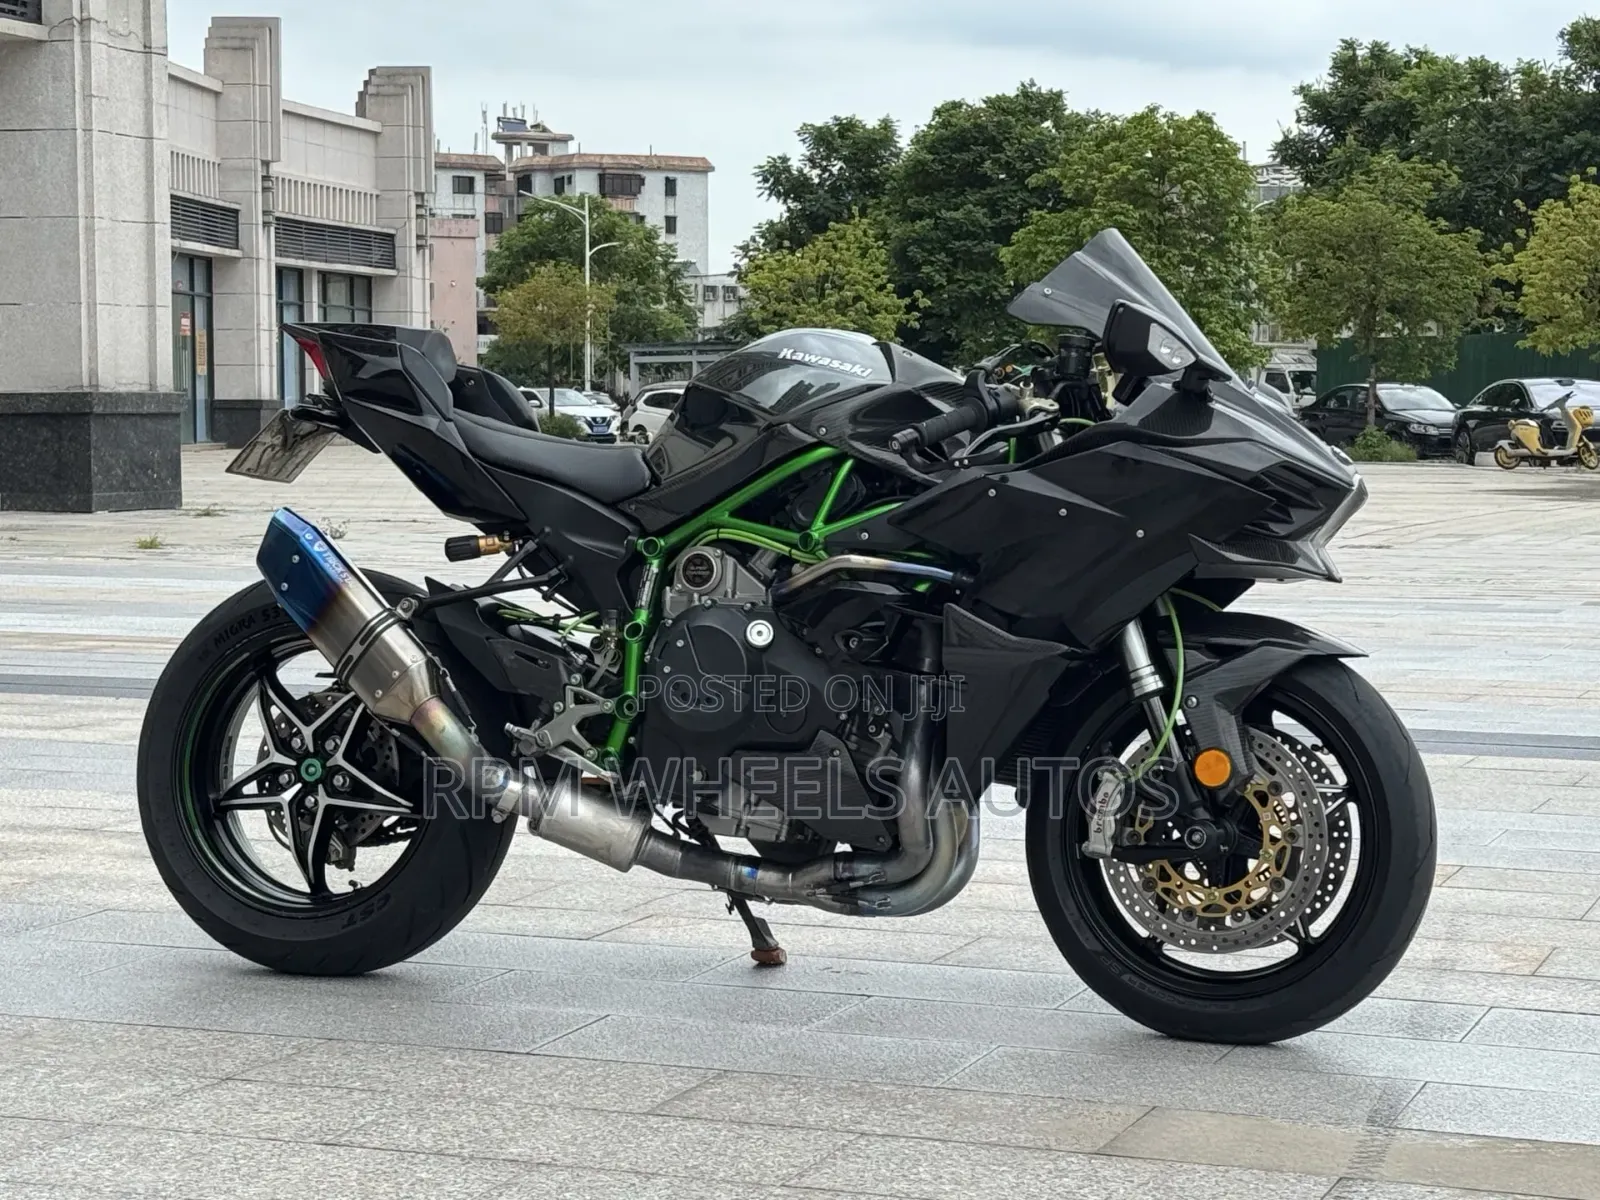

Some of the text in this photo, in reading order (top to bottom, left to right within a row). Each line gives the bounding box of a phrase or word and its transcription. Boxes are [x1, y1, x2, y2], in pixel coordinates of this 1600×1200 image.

[777, 347, 874, 378] Kawasaki
[213, 613, 257, 649] MIGRA
[1093, 791, 1109, 834] brembo
